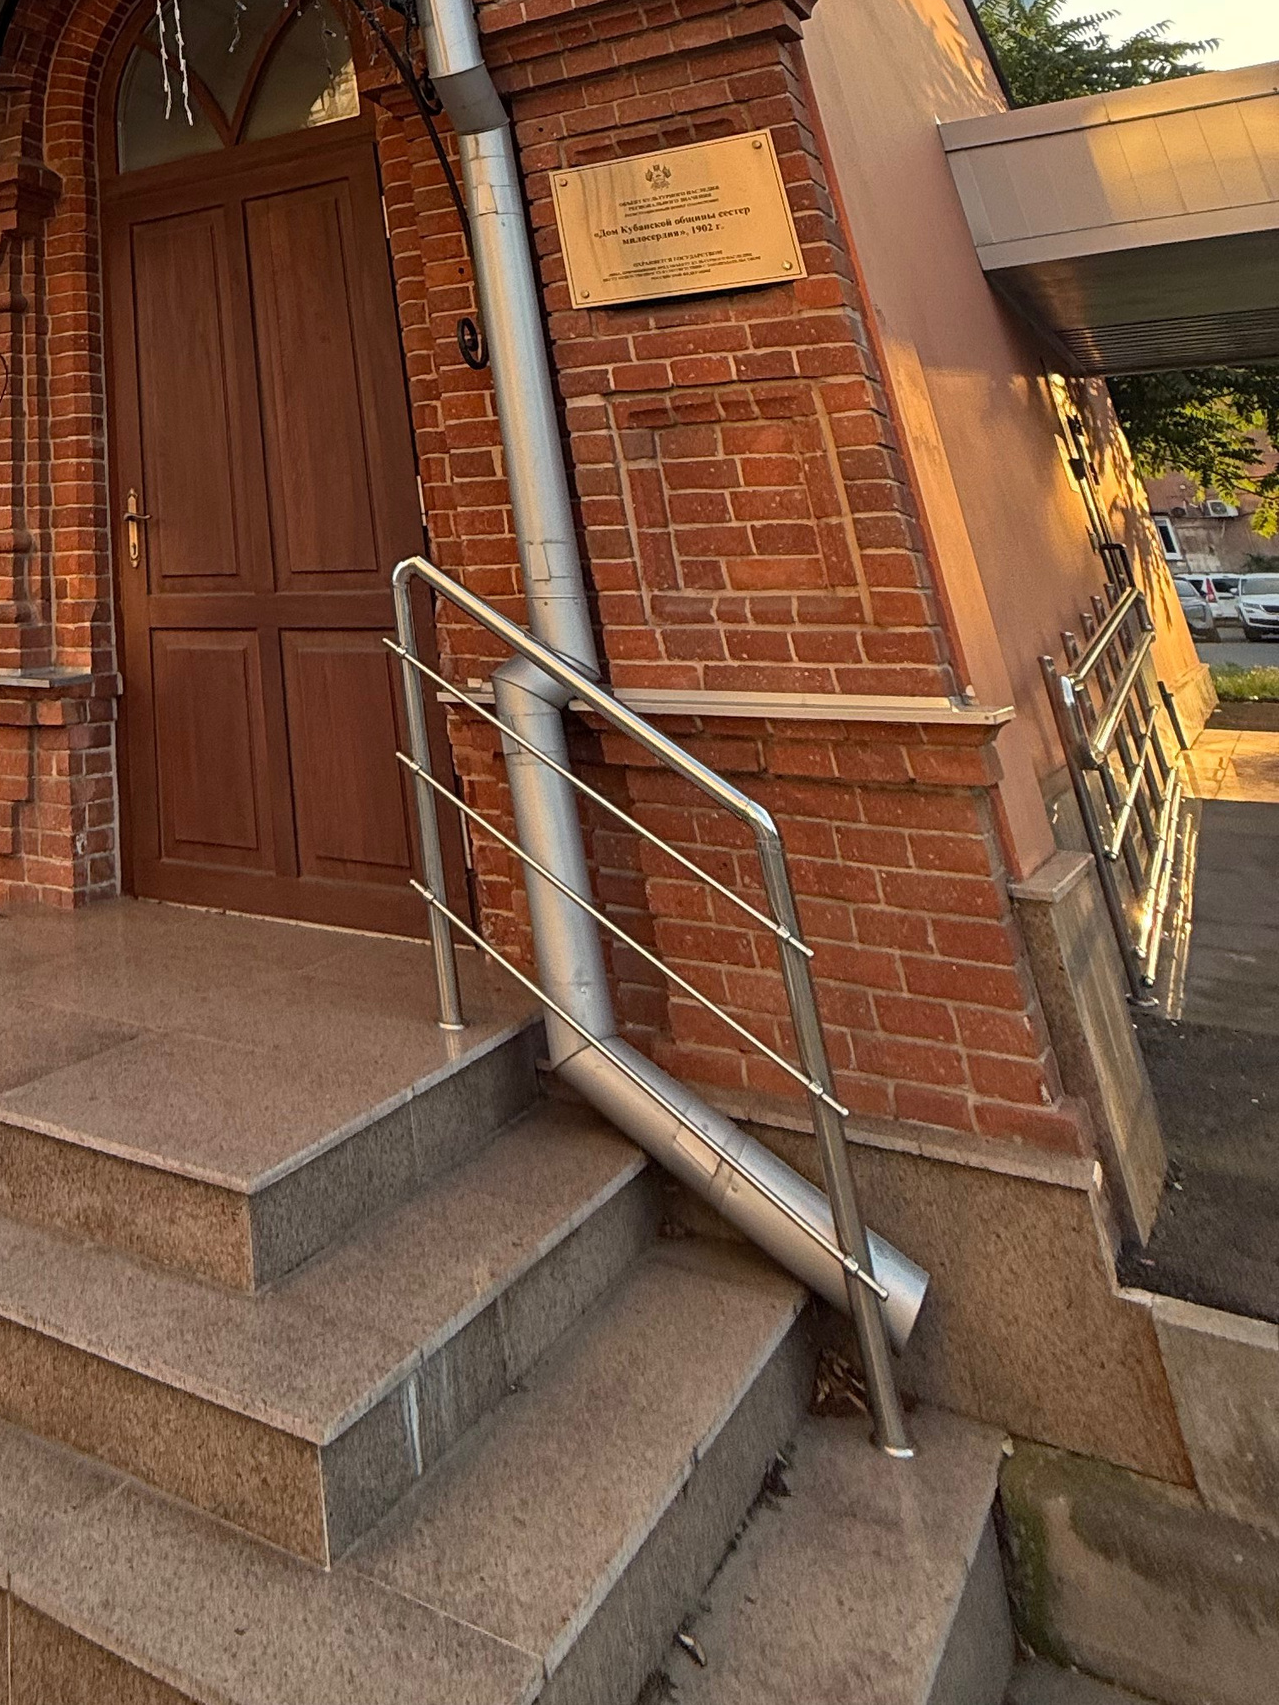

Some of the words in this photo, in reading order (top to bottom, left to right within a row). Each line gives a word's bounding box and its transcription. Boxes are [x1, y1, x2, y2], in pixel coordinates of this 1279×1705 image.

[621, 219, 672, 235] Кубанской
[674, 212, 716, 226] общины
[717, 206, 751, 218] сестер
[691, 223, 713, 234] 1902
[715, 223, 725, 231] г.
